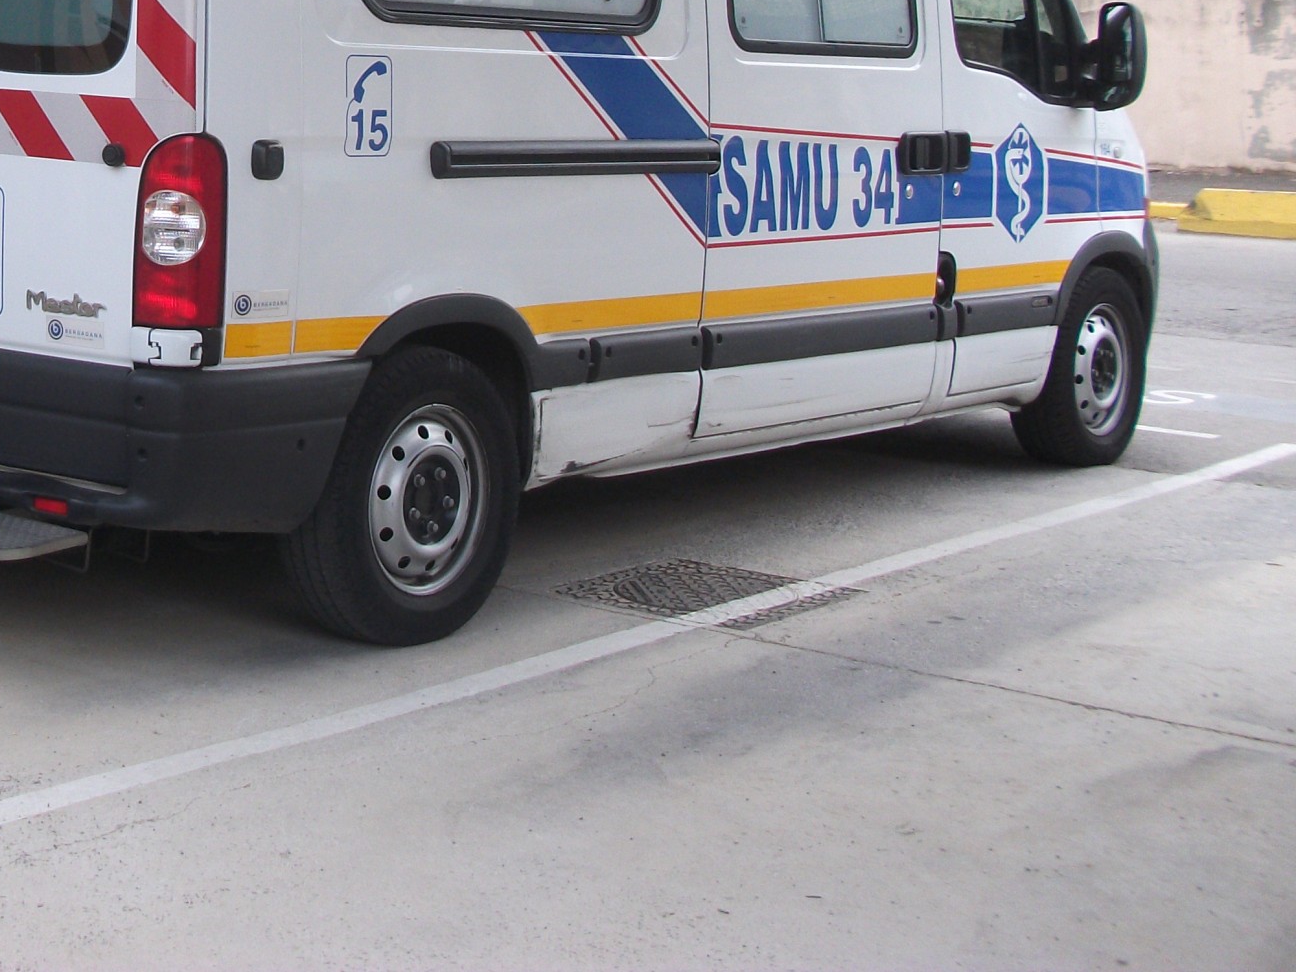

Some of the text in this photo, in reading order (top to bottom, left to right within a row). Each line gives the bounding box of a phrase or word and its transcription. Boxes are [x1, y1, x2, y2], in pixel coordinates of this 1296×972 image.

[351, 108, 388, 152] 15
[722, 134, 896, 237] SAMU 34
[26, 289, 107, 318] Master
